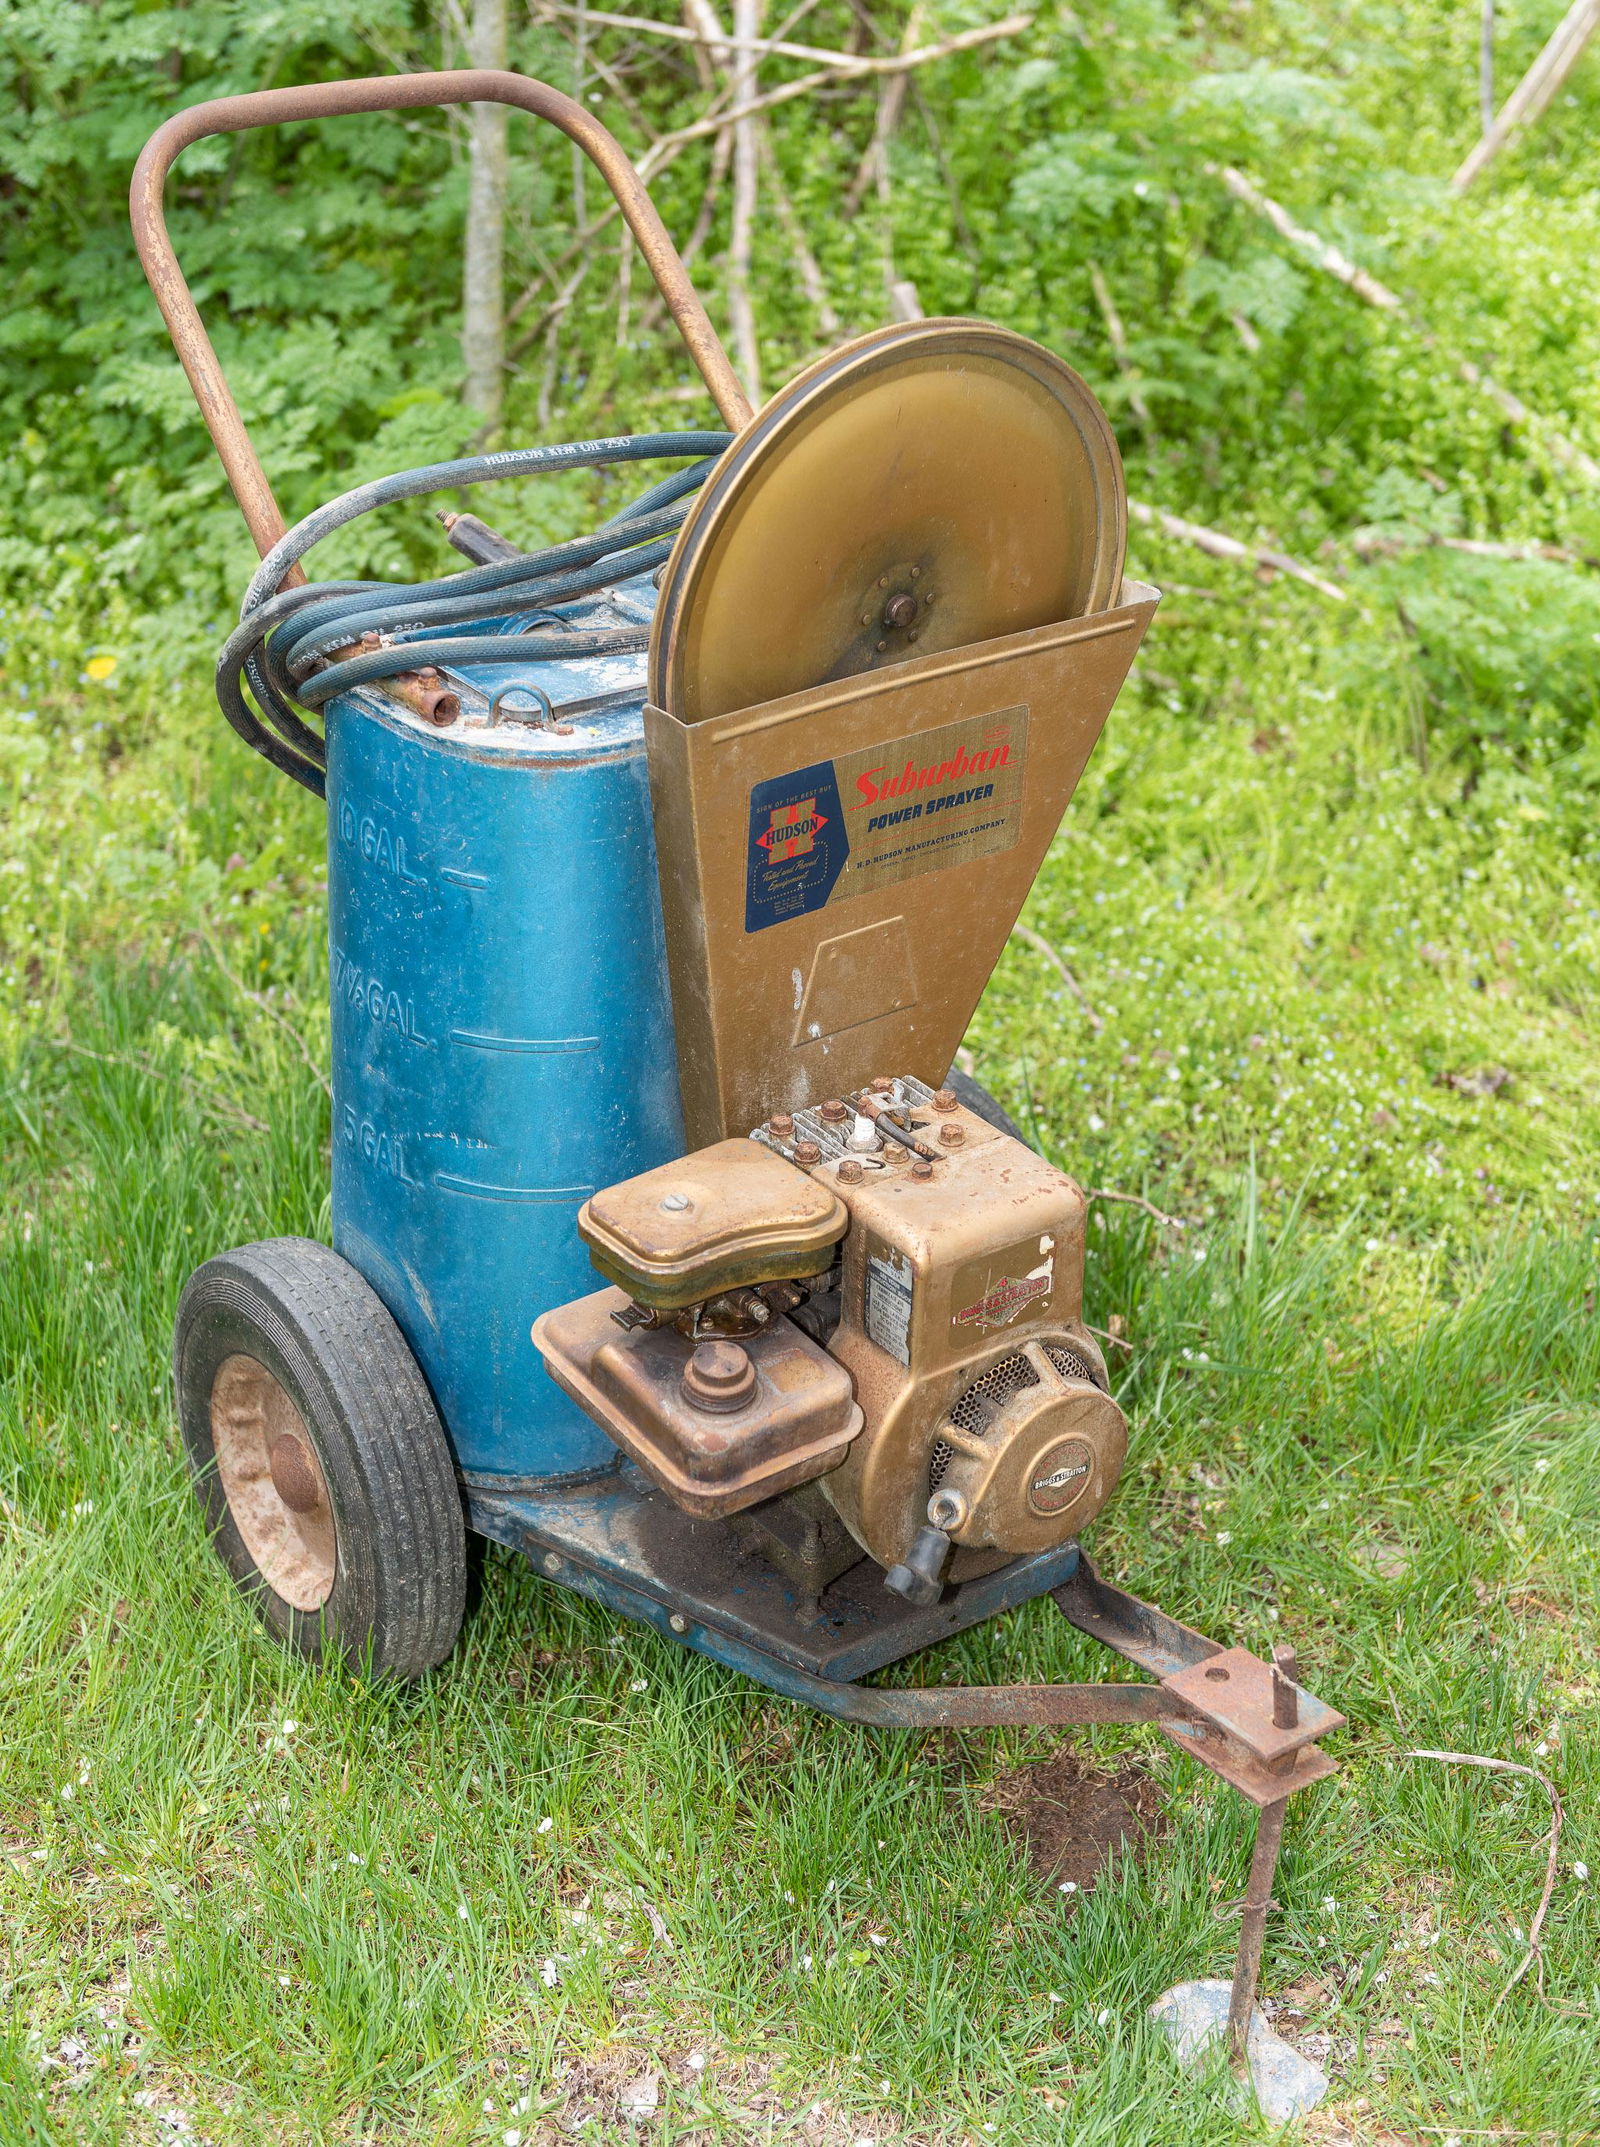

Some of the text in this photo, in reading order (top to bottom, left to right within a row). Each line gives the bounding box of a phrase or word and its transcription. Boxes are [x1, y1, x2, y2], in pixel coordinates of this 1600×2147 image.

[484, 450, 545, 465] HUDSON
[604, 437, 631, 449] 250
[848, 744, 1019, 811] Suburban
[337, 798, 358, 848] 10
[868, 784, 994, 832] POWER SPRAYER
[765, 816, 819, 846] HUDSON
[873, 849, 903, 863] HUDSON
[905, 829, 968, 853] MANUFACTURING
[970, 818, 1006, 834] COMPANY
[343, 1103, 357, 1149] 5
[1034, 1475, 1056, 1490] BRIGGS
[1060, 1465, 1087, 1480] STRATTON
